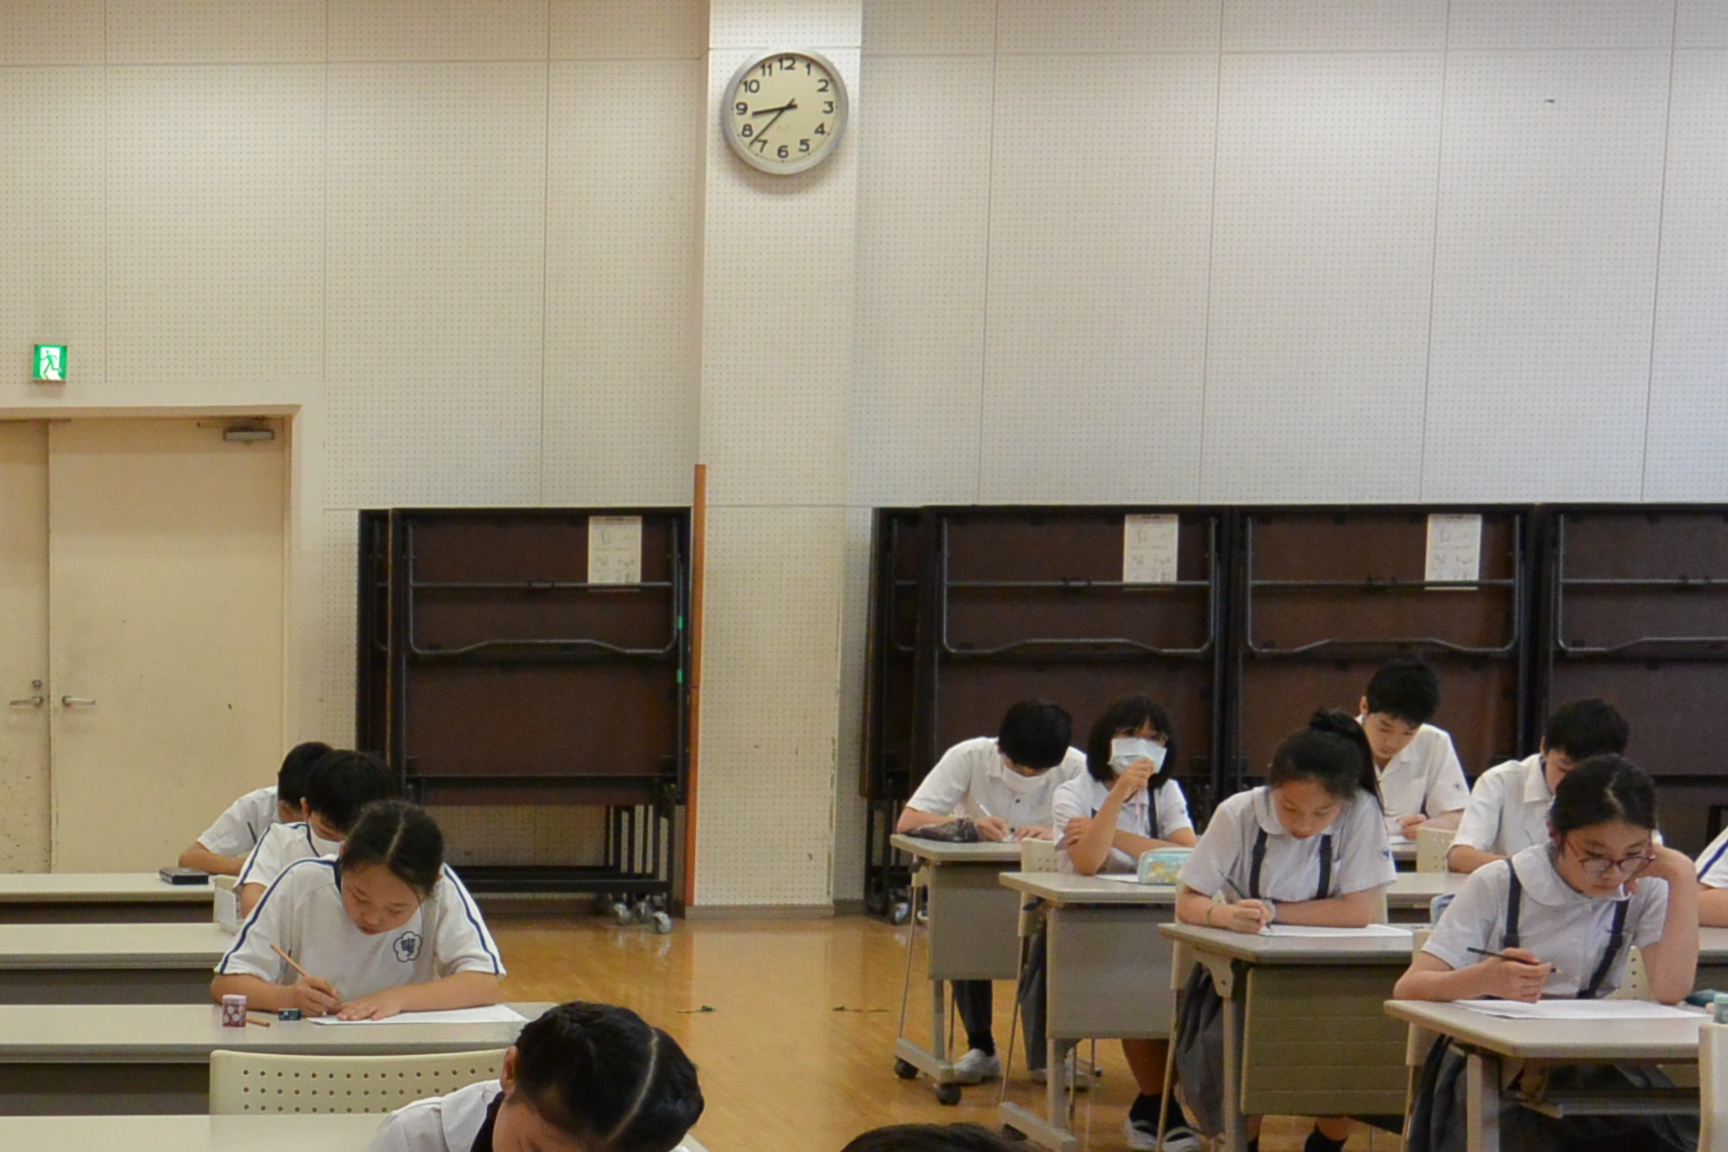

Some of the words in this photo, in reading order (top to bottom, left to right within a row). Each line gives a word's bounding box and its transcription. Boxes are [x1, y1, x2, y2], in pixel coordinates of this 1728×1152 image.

[760, 64, 772, 76] 11
[778, 57, 795, 70] 12
[805, 63, 811, 76] 1
[743, 80, 760, 93] 10
[817, 79, 829, 92] 2
[736, 102, 748, 115] 9
[823, 101, 834, 114] 3
[741, 124, 753, 137] 8
[814, 123, 825, 135] 4
[756, 140, 768, 153] 7
[777, 145, 789, 158] 6
[799, 139, 810, 152] 5
